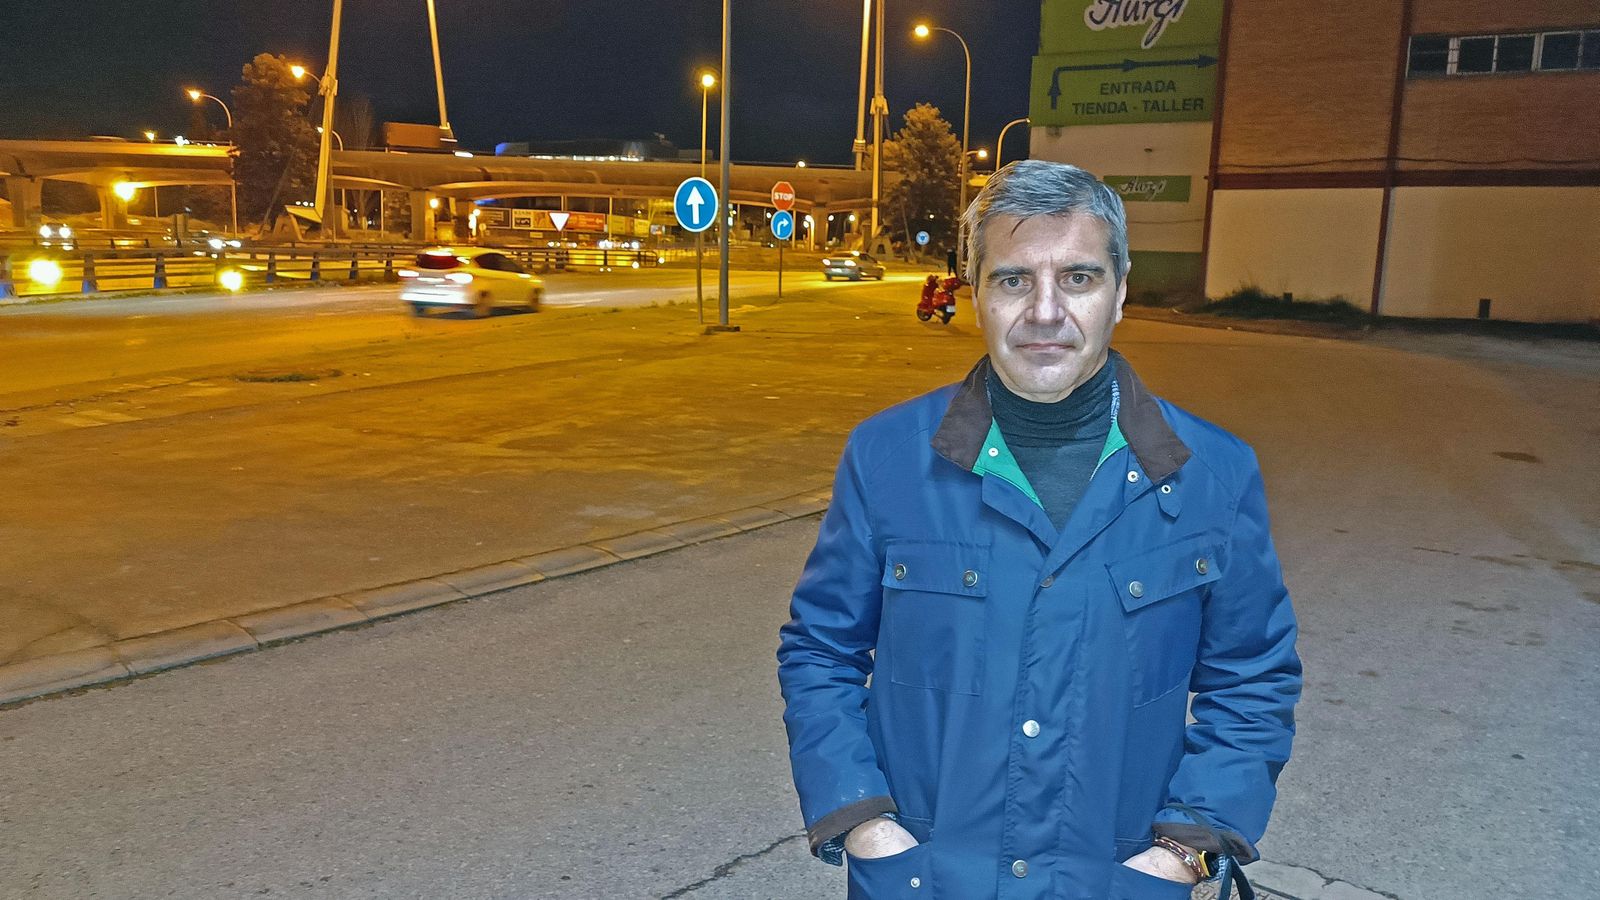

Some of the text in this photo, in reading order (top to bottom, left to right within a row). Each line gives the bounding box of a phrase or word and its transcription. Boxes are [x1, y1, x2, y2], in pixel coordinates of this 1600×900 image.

[1100, 80, 1177, 95] ENTRADA
[1072, 101, 1128, 115] TIENDA
[1143, 98, 1204, 112] TALLER
[774, 191, 793, 200] STOP
